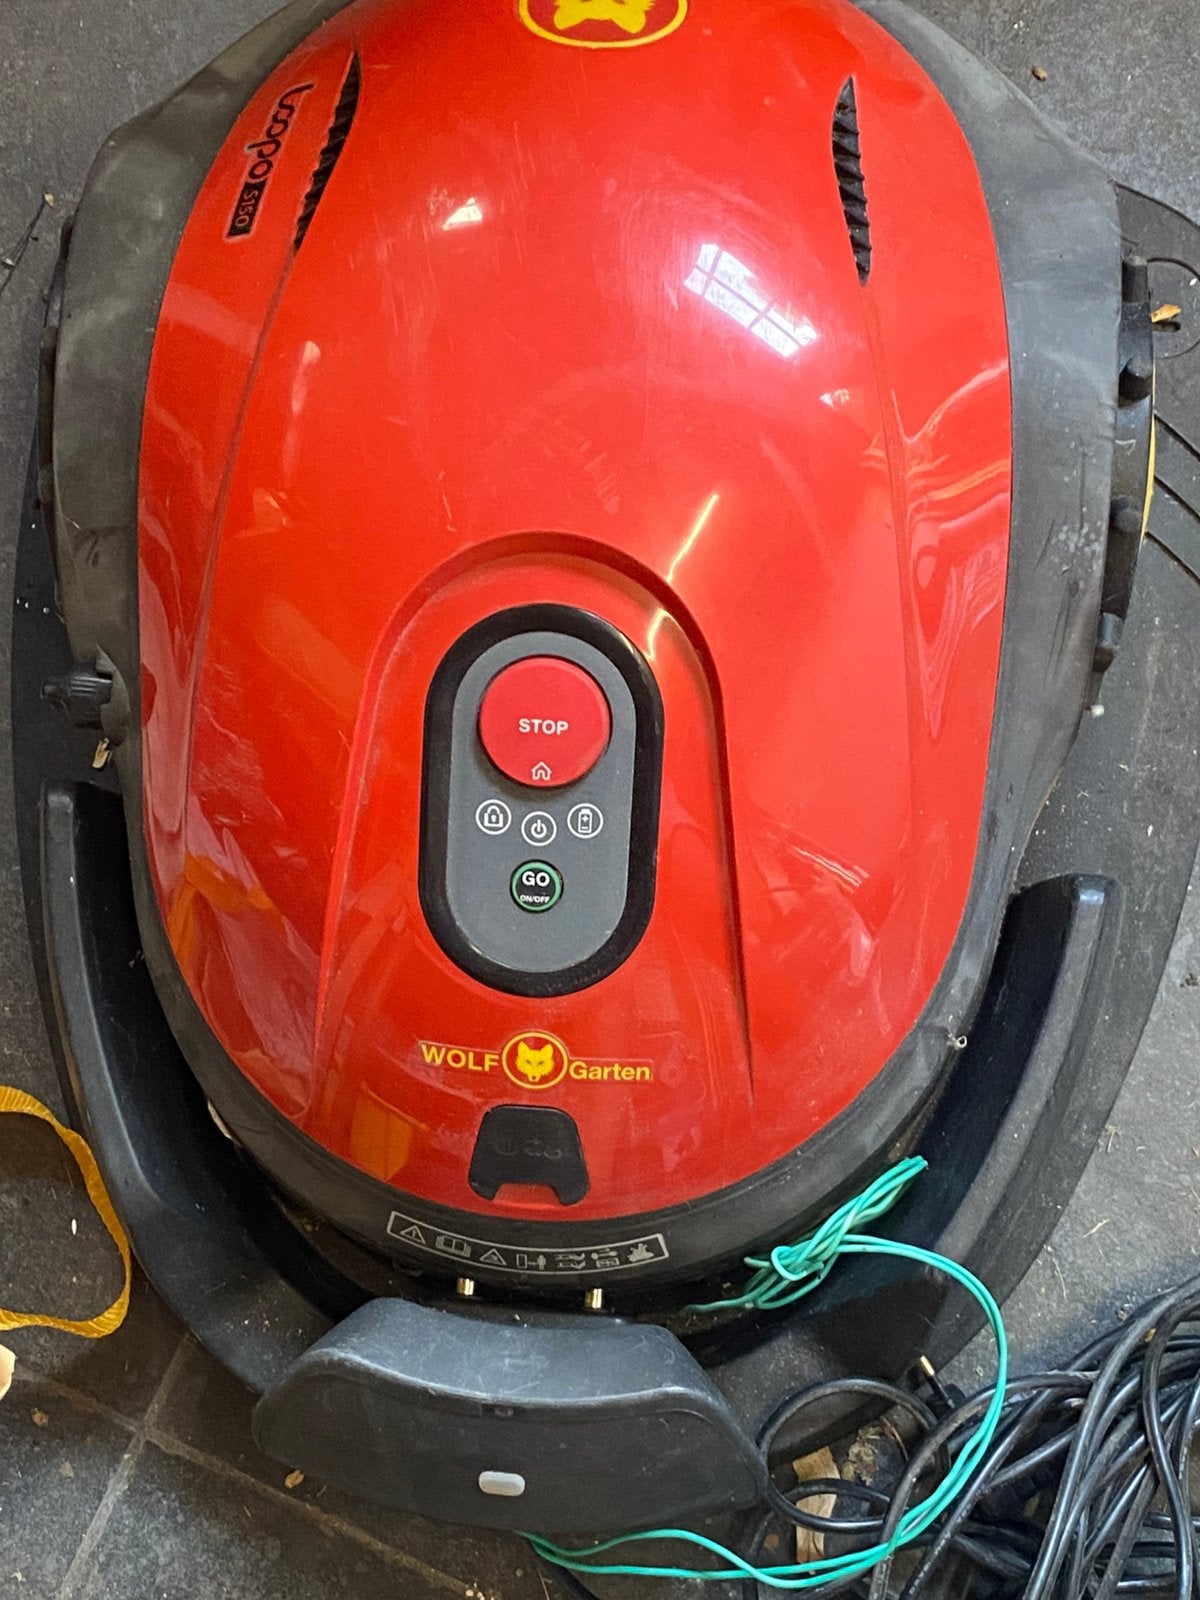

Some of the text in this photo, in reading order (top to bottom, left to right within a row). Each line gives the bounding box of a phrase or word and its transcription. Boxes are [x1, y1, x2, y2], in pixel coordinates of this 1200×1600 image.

[234, 190, 259, 228] S150
[518, 718, 569, 736] STOP
[521, 870, 550, 887] GO
[519, 894, 551, 904] ON/OFF
[420, 1043, 651, 1081] WOLF Garten
